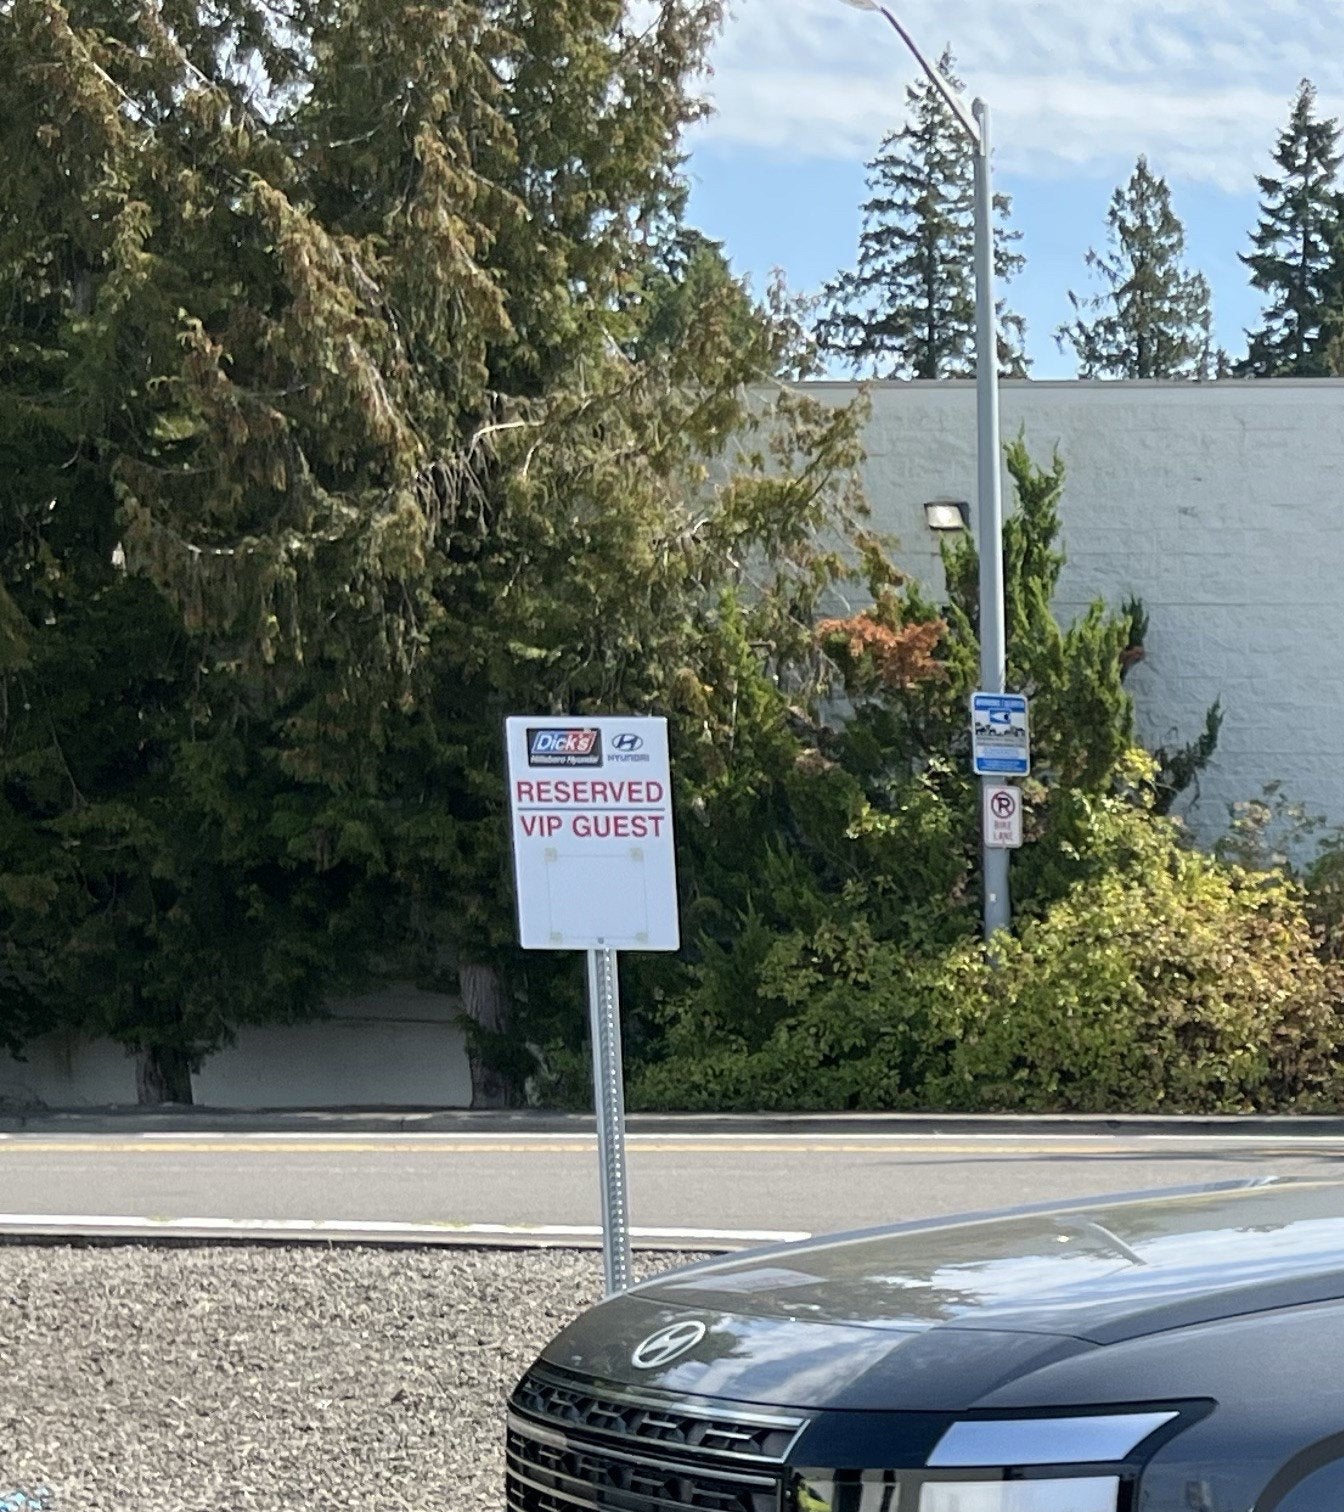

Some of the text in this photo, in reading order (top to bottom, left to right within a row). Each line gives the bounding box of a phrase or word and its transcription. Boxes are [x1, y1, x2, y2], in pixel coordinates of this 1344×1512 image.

[516, 781, 664, 803] RESERVED
[520, 815, 665, 838] VIP GUEST
